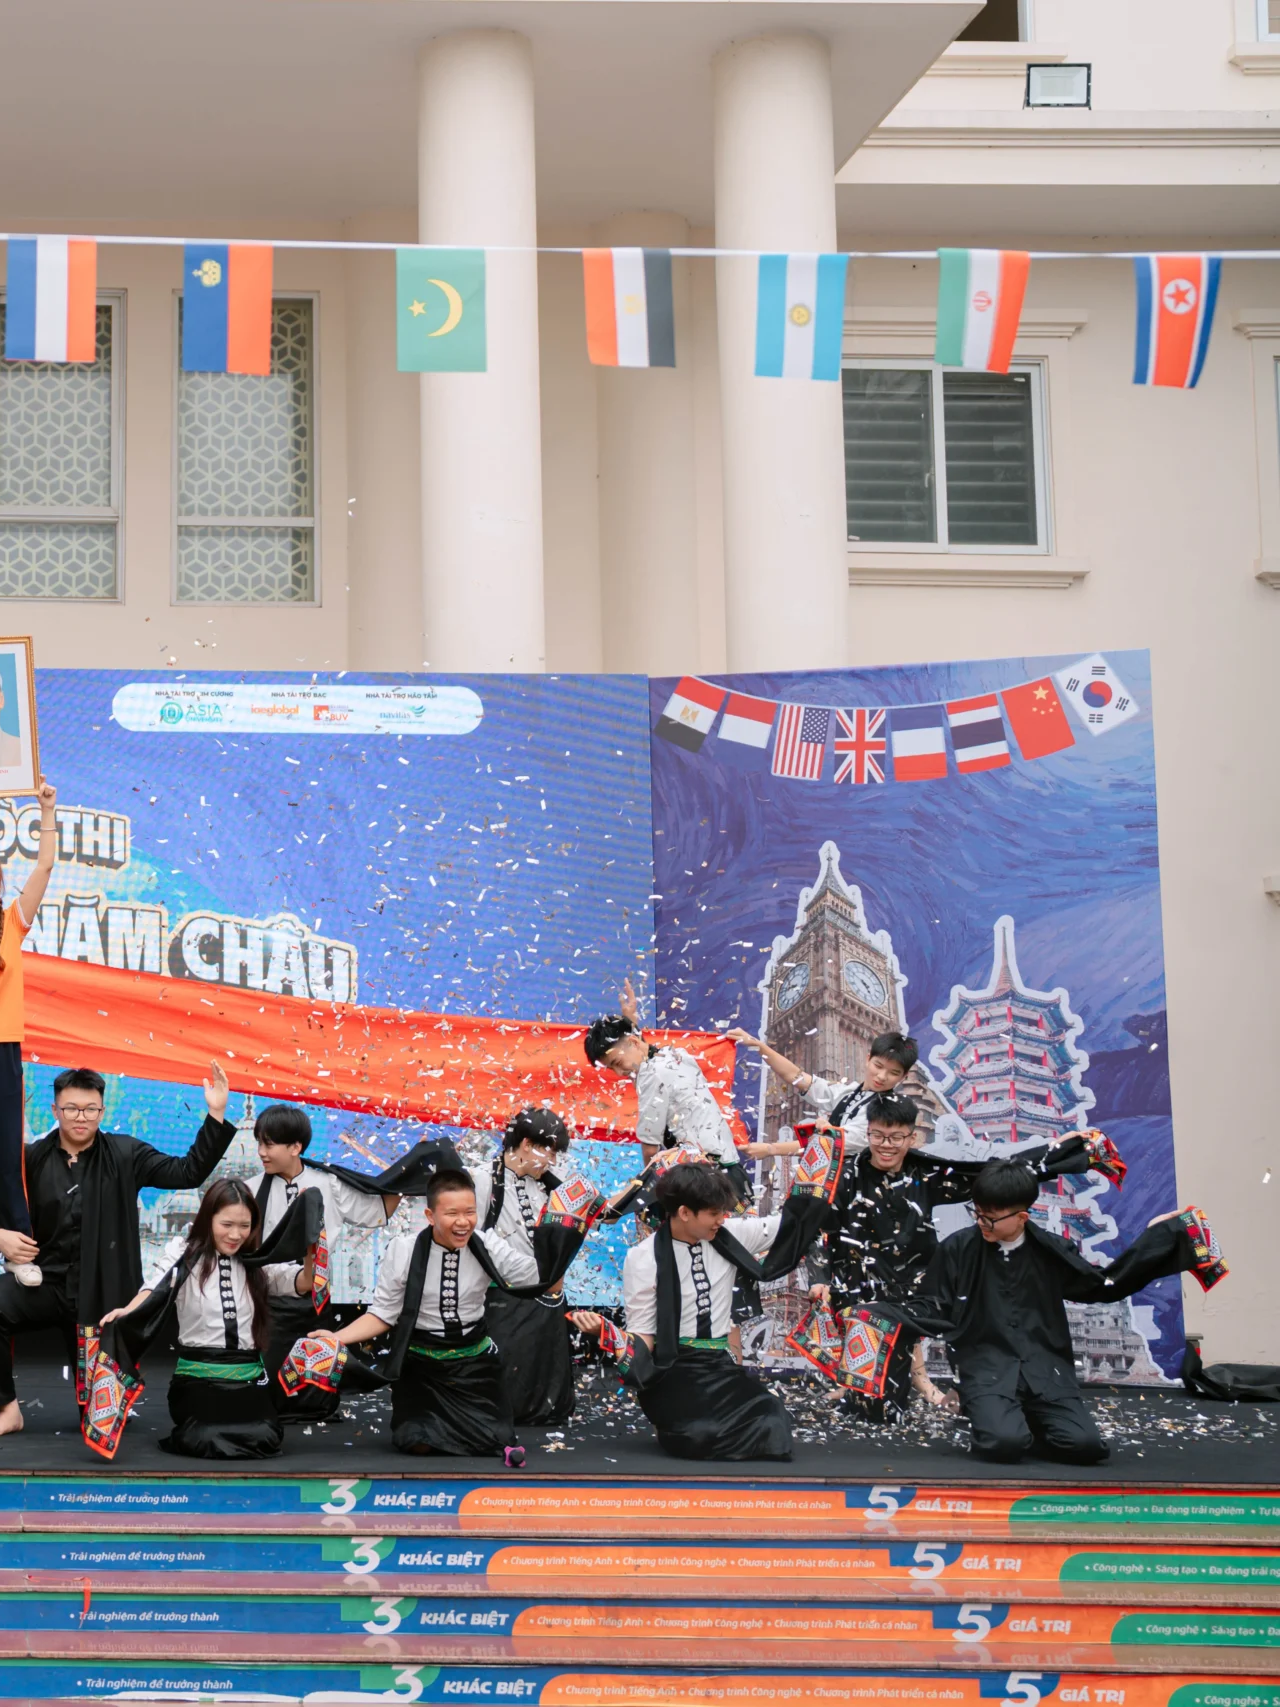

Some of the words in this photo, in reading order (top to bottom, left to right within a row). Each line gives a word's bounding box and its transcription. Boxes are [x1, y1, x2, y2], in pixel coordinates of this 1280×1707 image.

[186, 704, 223, 716] ASIA
[251, 704, 299, 716] iaeglobal
[54, 808, 130, 866] THI
[180, 917, 350, 1003] CHÂU
[320, 1479, 359, 1514] 3
[373, 1492, 417, 1508] KHÁC
[420, 1492, 456, 1508] BIỆT
[863, 1486, 902, 1520] 5
[915, 1499, 943, 1512] GIÁ
[946, 1501, 973, 1515] TRỊ
[342, 1537, 383, 1574] 3
[398, 1550, 444, 1566] KHÁC
[446, 1551, 484, 1568] BIỆT
[908, 1542, 947, 1580] 5
[962, 1555, 990, 1570] GIÁ
[994, 1558, 1022, 1572] TRỊ
[362, 1596, 406, 1635] 3
[420, 1610, 467, 1625] KHÁC
[470, 1610, 510, 1628] BIỆT
[953, 1604, 993, 1642] 5
[1008, 1617, 1038, 1632] GIÁ
[1042, 1620, 1072, 1635] TRỊ
[86, 1678, 106, 1688] Trải
[106, 1678, 148, 1690] nghiệm
[148, 1678, 164, 1689] để
[164, 1679, 201, 1690] trưởng
[202, 1679, 233, 1690] thành
[382, 1666, 424, 1704] 3
[443, 1678, 492, 1694] KHÁC
[495, 1678, 537, 1698] BIỆT
[565, 1685, 602, 1697] Chương
[604, 1686, 627, 1695] trình
[629, 1686, 656, 1698] Tiếng
[656, 1686, 677, 1696] Anh
[688, 1687, 725, 1699] Chương
[726, 1686, 750, 1696] trình
[750, 1687, 776, 1699] Công
[776, 1687, 802, 1699] nghệ
[813, 1687, 851, 1699] Chương
[852, 1688, 876, 1698] trình
[876, 1688, 900, 1698] Phát
[900, 1688, 925, 1698] triển
[926, 1690, 938, 1699] cá
[938, 1690, 964, 1699] nhân
[1000, 1672, 1043, 1707] 5
[1059, 1686, 1090, 1702] GIÁ
[1094, 1689, 1125, 1705] TRỊ
